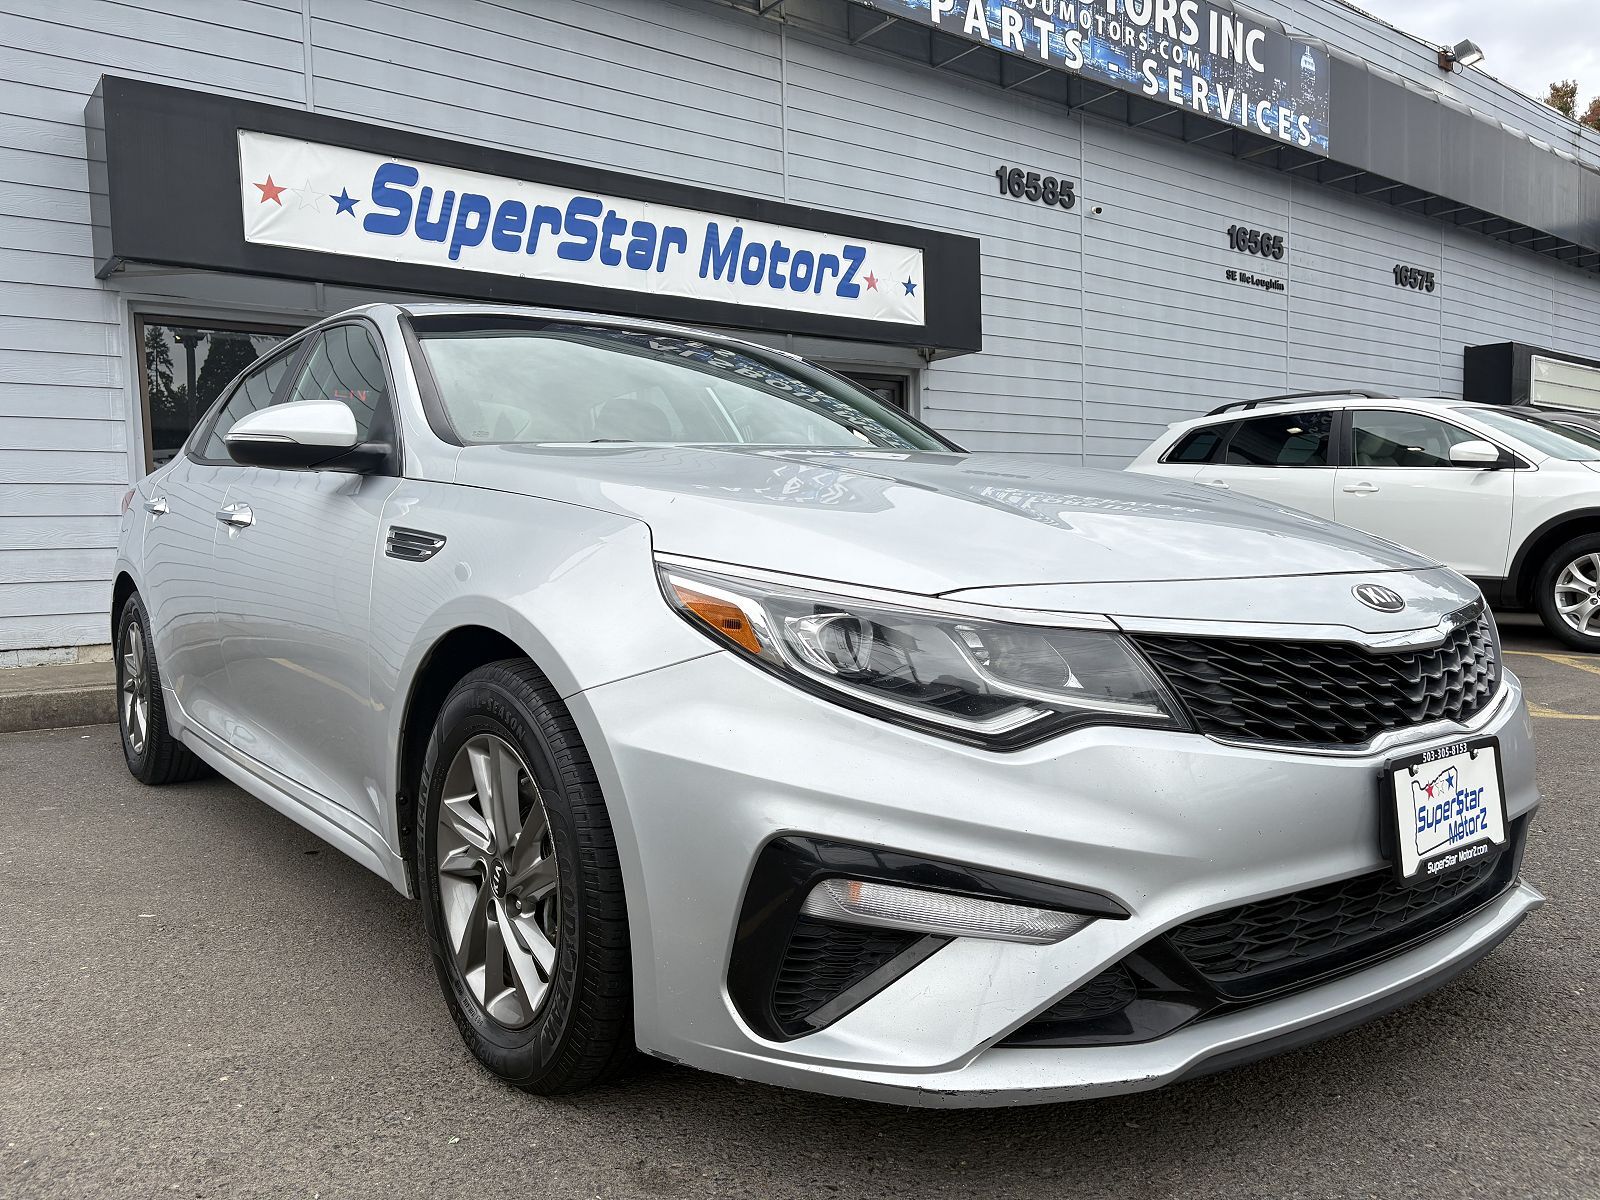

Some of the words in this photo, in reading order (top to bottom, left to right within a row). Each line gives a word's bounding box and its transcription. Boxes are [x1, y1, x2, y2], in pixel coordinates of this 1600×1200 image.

[1208, 9, 1265, 73] INC
[930, 0, 1084, 70] PARTS
[1141, 58, 1311, 148] SERVICES
[996, 165, 1076, 209] 16585
[363, 162, 688, 273] SuperStar
[699, 222, 867, 299] MotorZ
[1227, 225, 1284, 260] 16565
[1225, 269, 1238, 281] SE
[1239, 272, 1285, 291] McLoughlin
[1393, 264, 1435, 292] 16575
[1422, 742, 1468, 763] 503-305-8153
[1417, 787, 1484, 833] SuperStar
[1448, 807, 1488, 845] MotorZ
[1427, 852, 1458, 874] SuperStar
[1458, 844, 1489, 863] MotorZ.com
